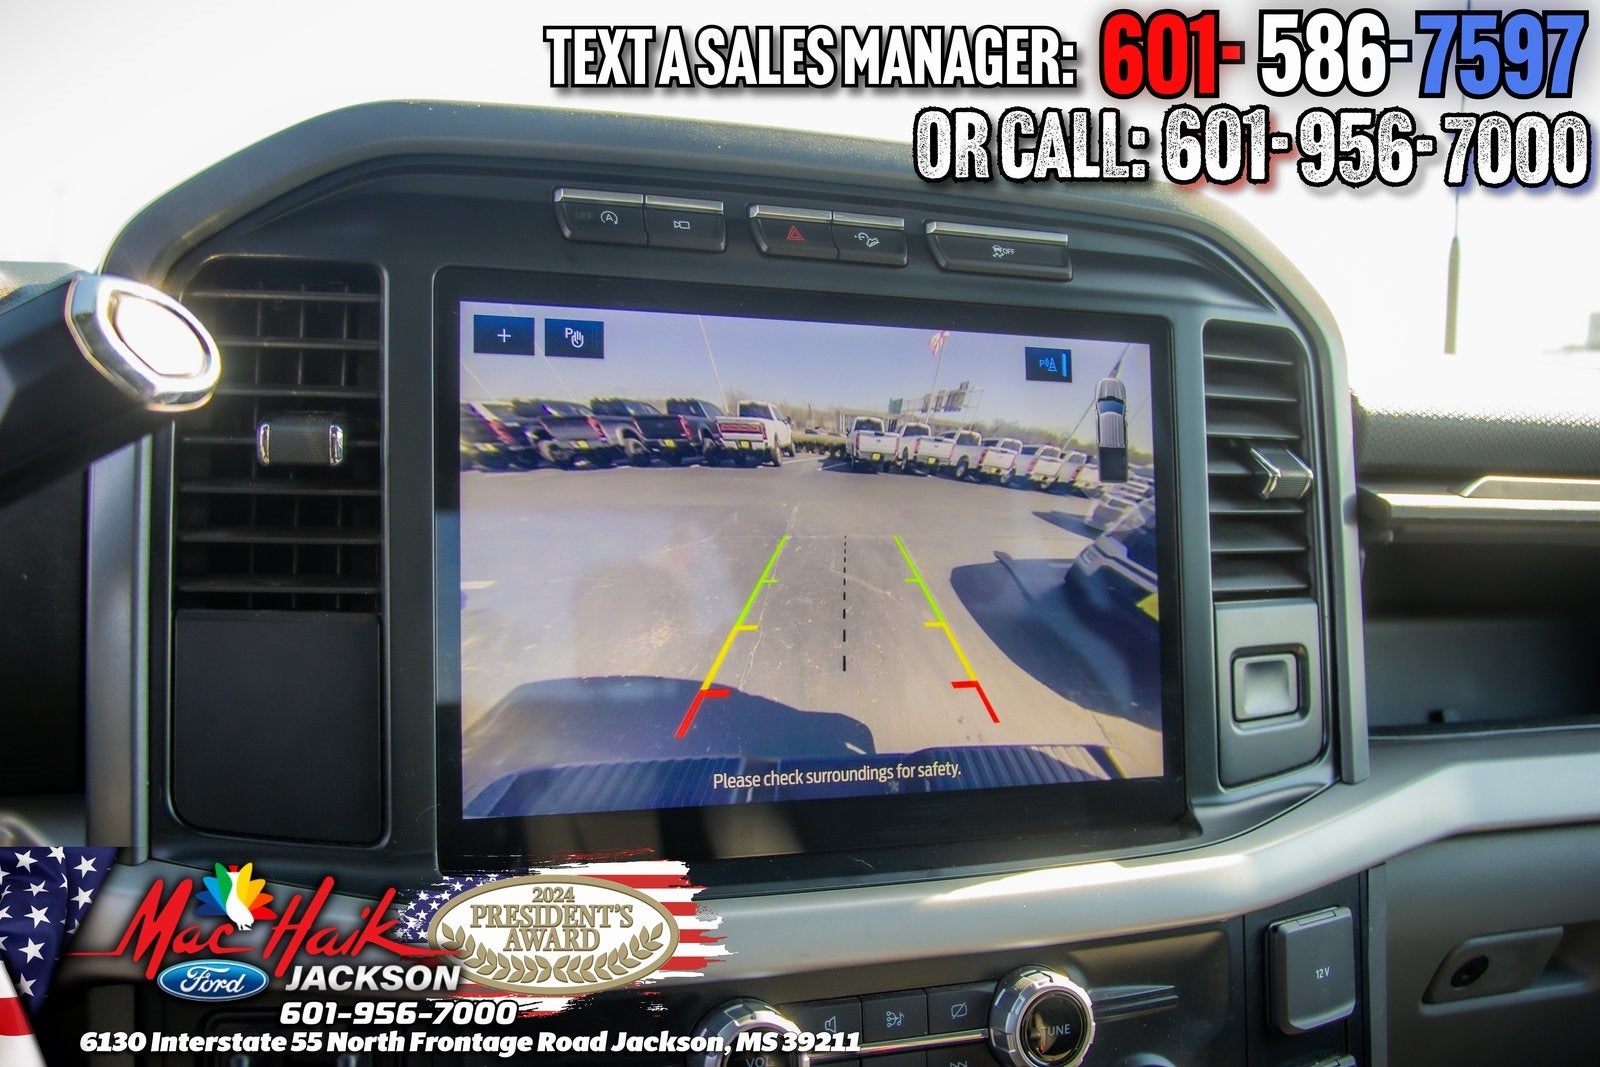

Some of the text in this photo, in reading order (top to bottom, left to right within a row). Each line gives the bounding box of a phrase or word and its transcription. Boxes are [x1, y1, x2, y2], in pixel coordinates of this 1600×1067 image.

[713, 760, 962, 790] Please check surroundings for safety.
[1040, 1023, 1071, 1037] TUNE
